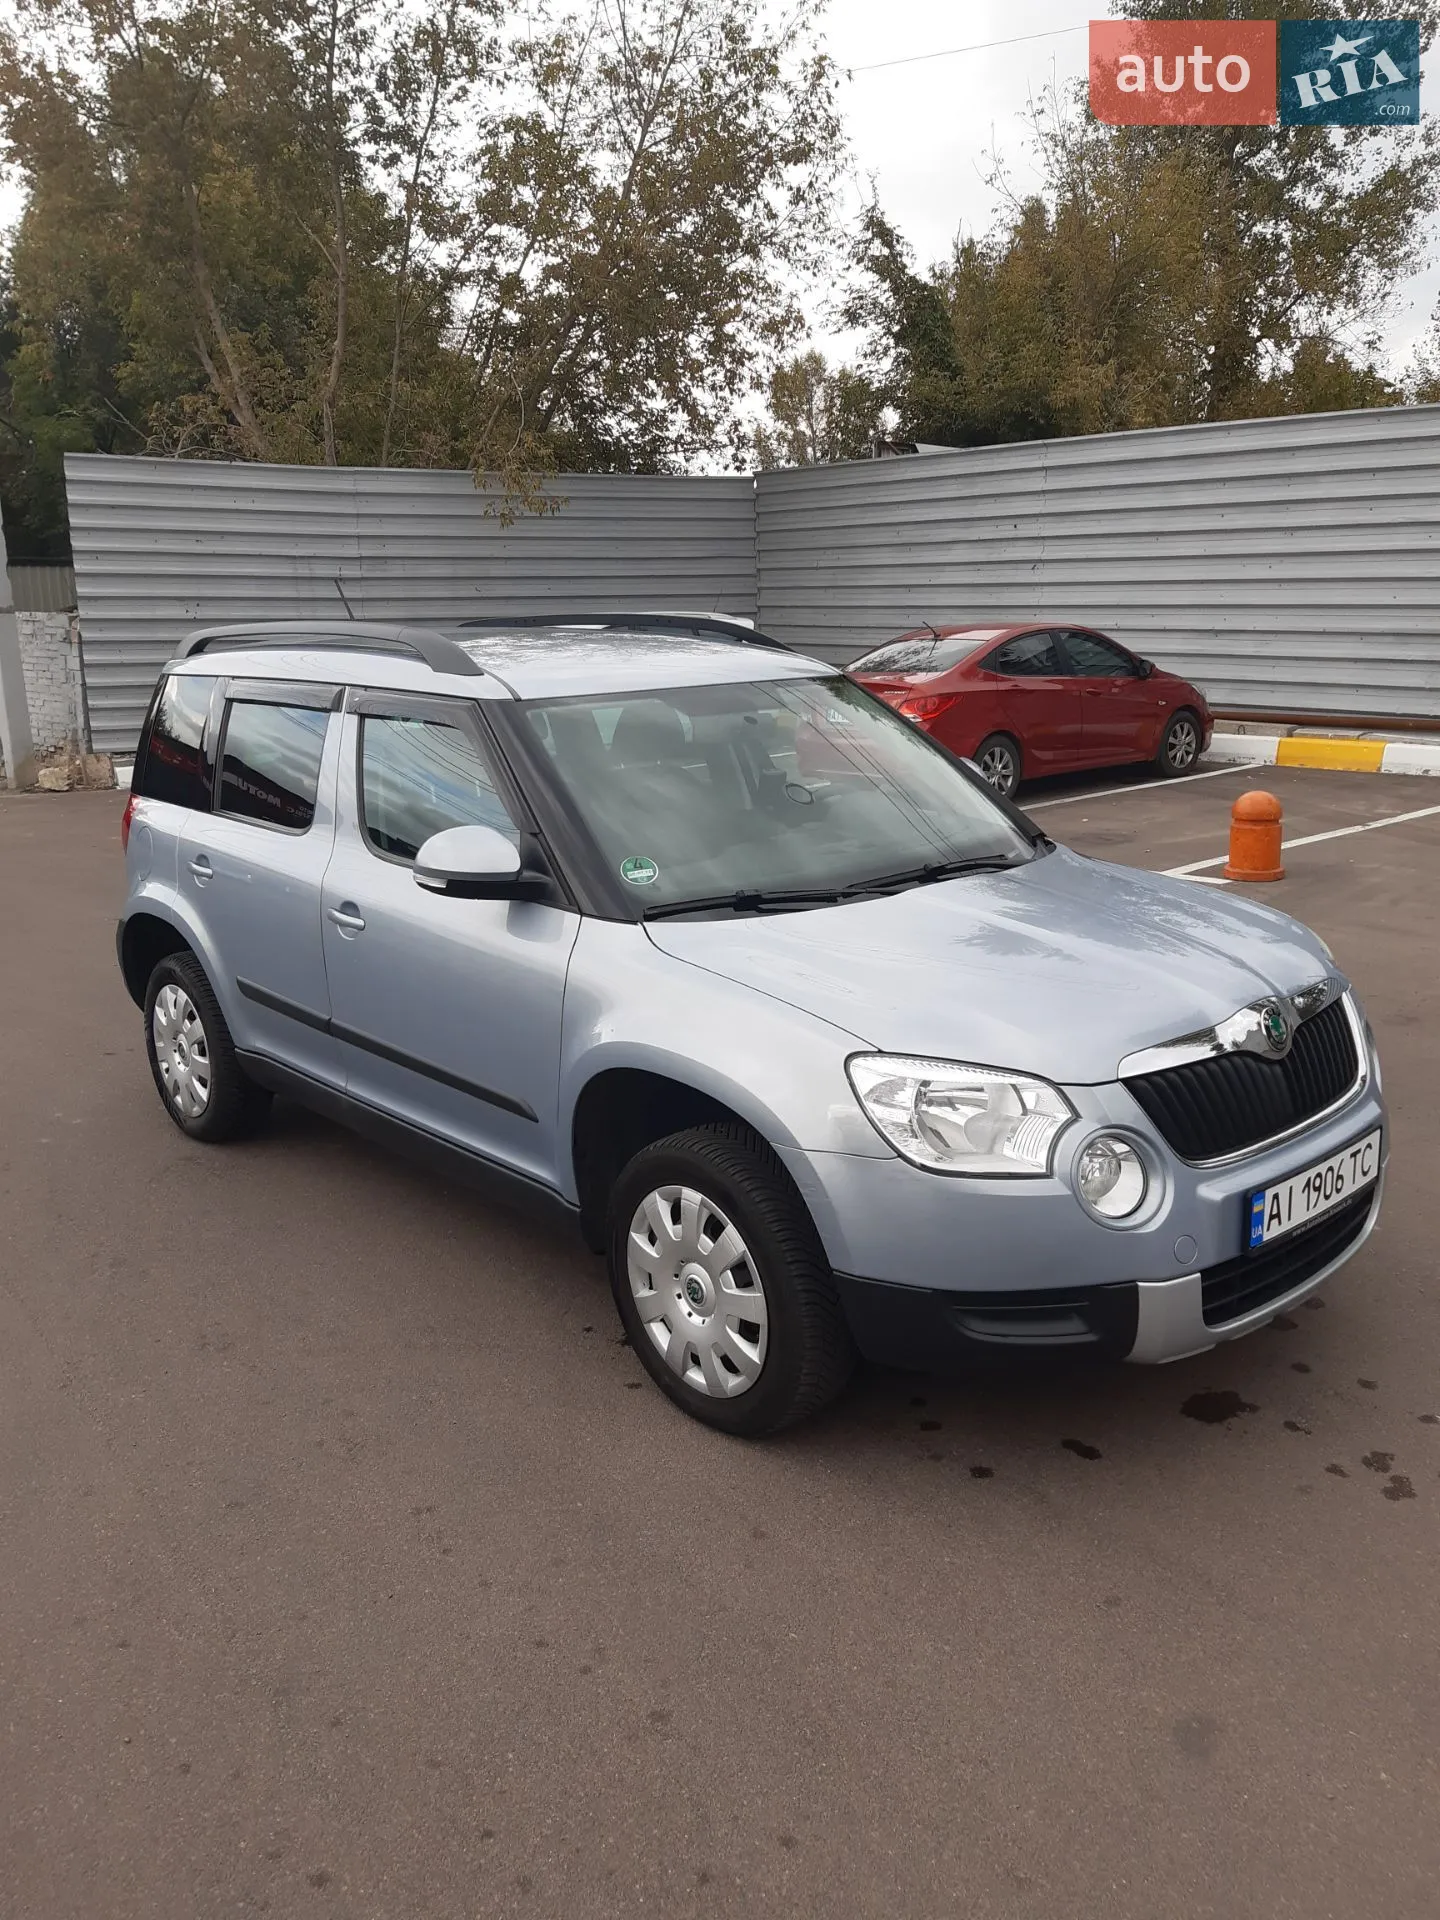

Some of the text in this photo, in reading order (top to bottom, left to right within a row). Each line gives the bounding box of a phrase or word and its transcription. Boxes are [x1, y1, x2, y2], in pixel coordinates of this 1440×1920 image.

[633, 858, 643, 870] 4
[1266, 1185, 1293, 1233] AI
[1302, 1158, 1345, 1212] 1906
[1350, 1142, 1373, 1185] TC
[1252, 1226, 1263, 1238] UA
